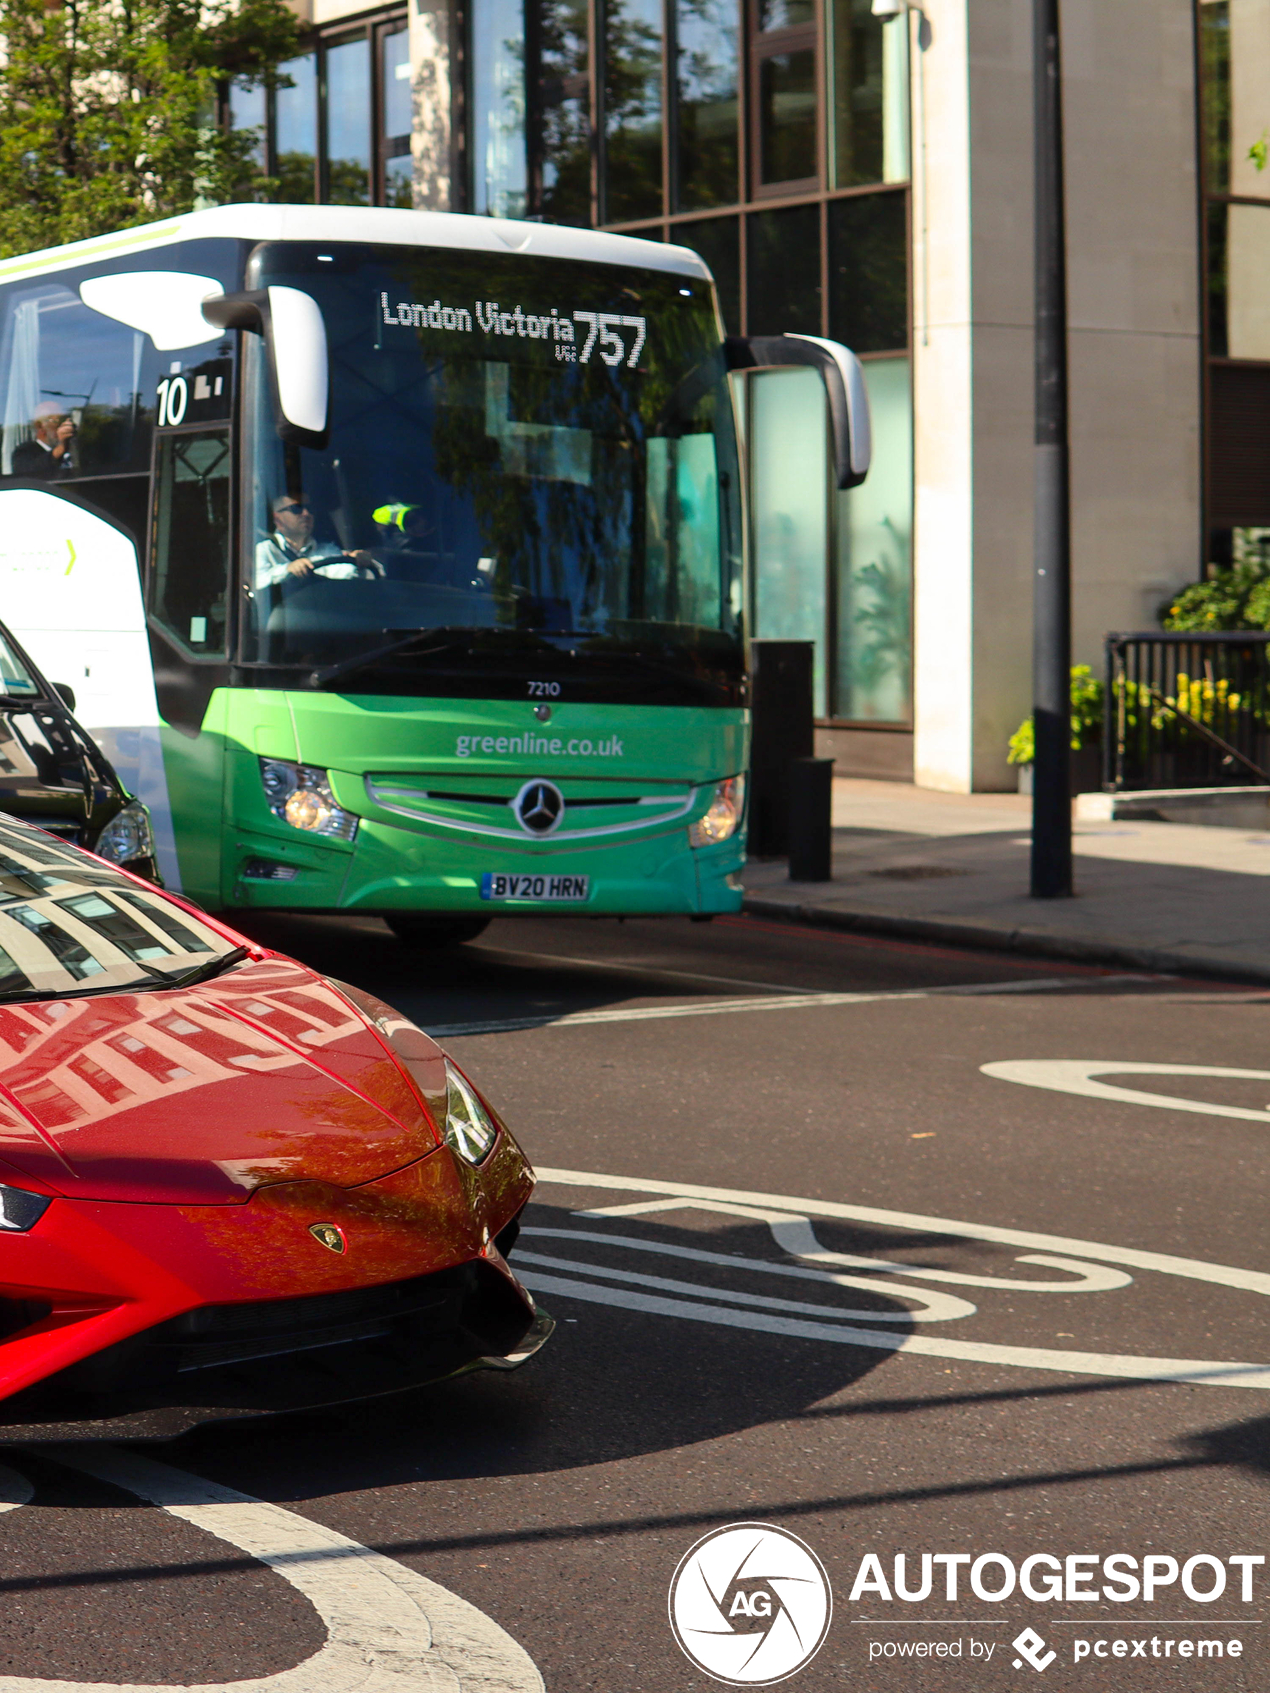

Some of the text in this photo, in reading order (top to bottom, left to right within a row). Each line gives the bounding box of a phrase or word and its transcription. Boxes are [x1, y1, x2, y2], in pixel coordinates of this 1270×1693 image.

[381, 291, 574, 342] London Victoria
[573, 310, 646, 368] 757
[156, 376, 188, 427] 10
[527, 681, 561, 696] 7210
[456, 732, 624, 757] greenline.co.uk
[494, 876, 586, 897] BV20 HRN
